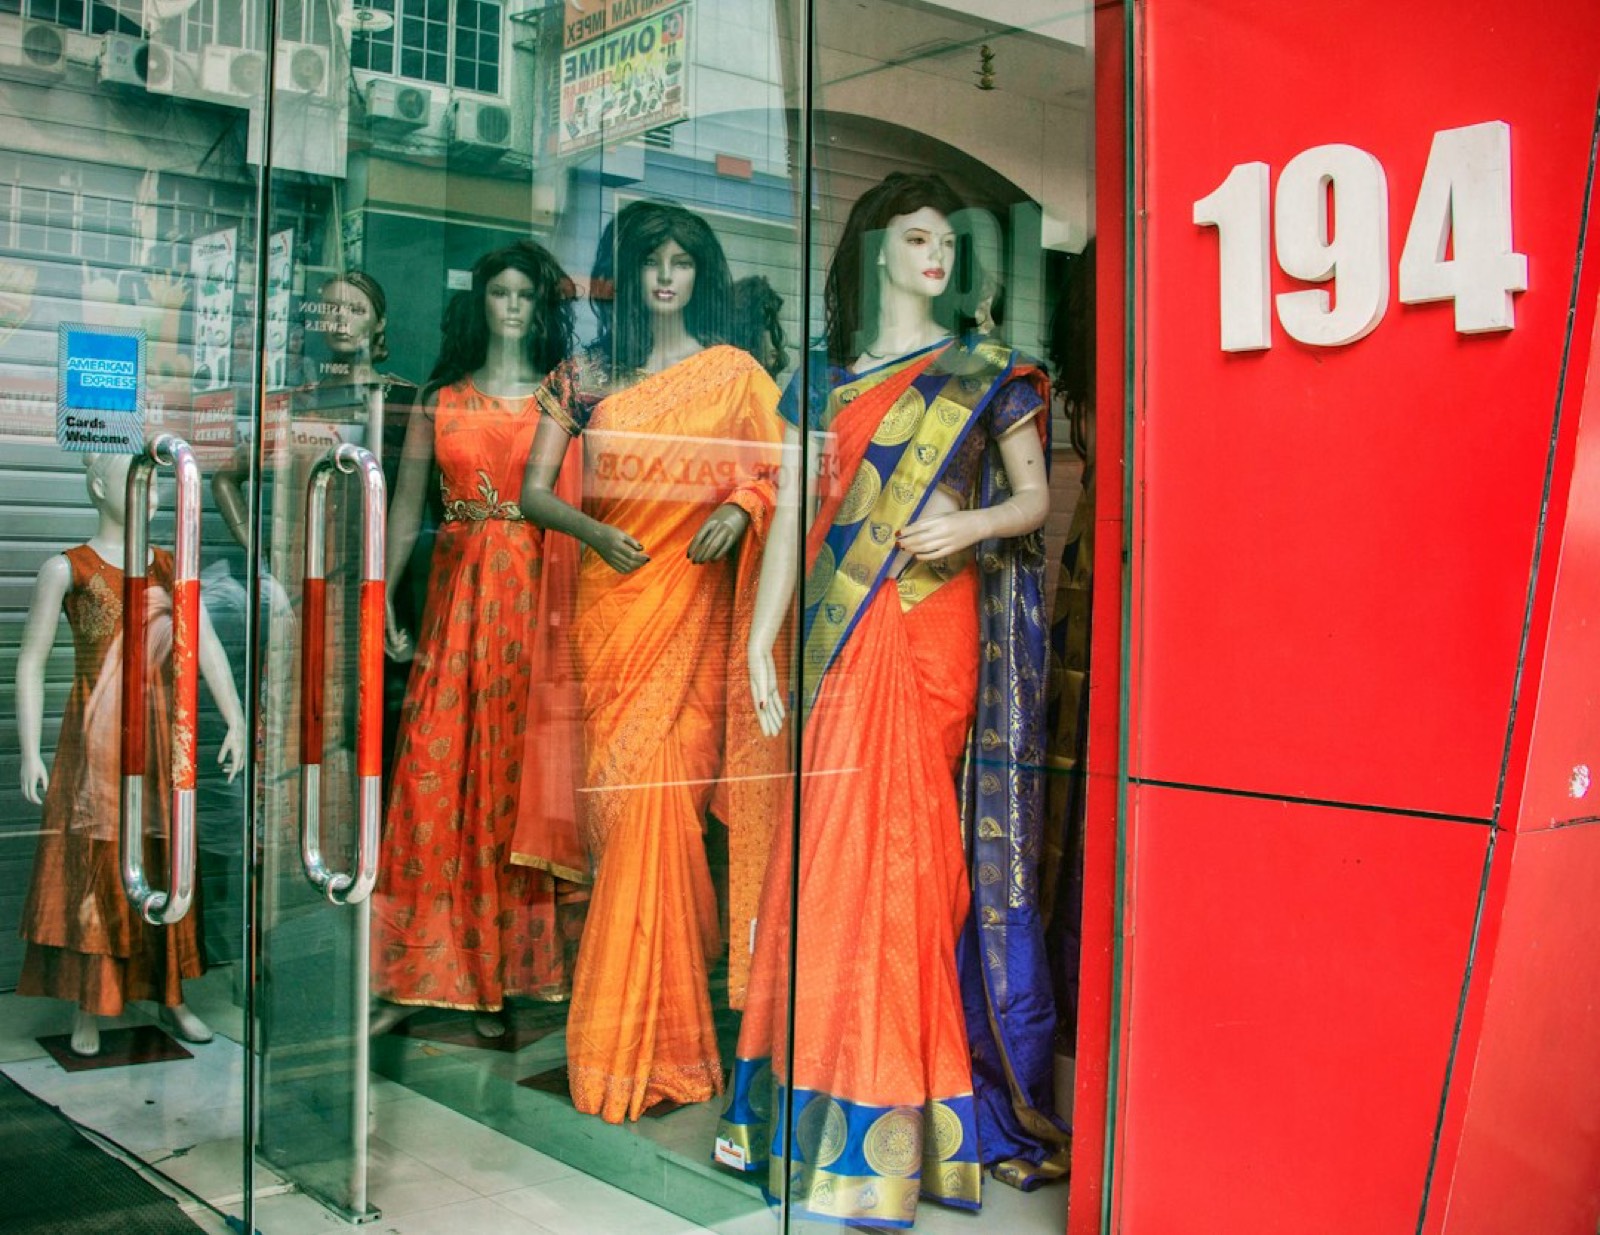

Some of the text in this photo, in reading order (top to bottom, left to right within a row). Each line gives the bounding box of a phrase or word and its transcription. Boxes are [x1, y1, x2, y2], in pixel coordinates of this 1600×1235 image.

[1193, 120, 1528, 353] 194
[67, 357, 134, 374] AMERICAN
[81, 373, 137, 389] EXPRESS
[66, 416, 106, 429] Cards
[66, 430, 130, 445] Welcome
